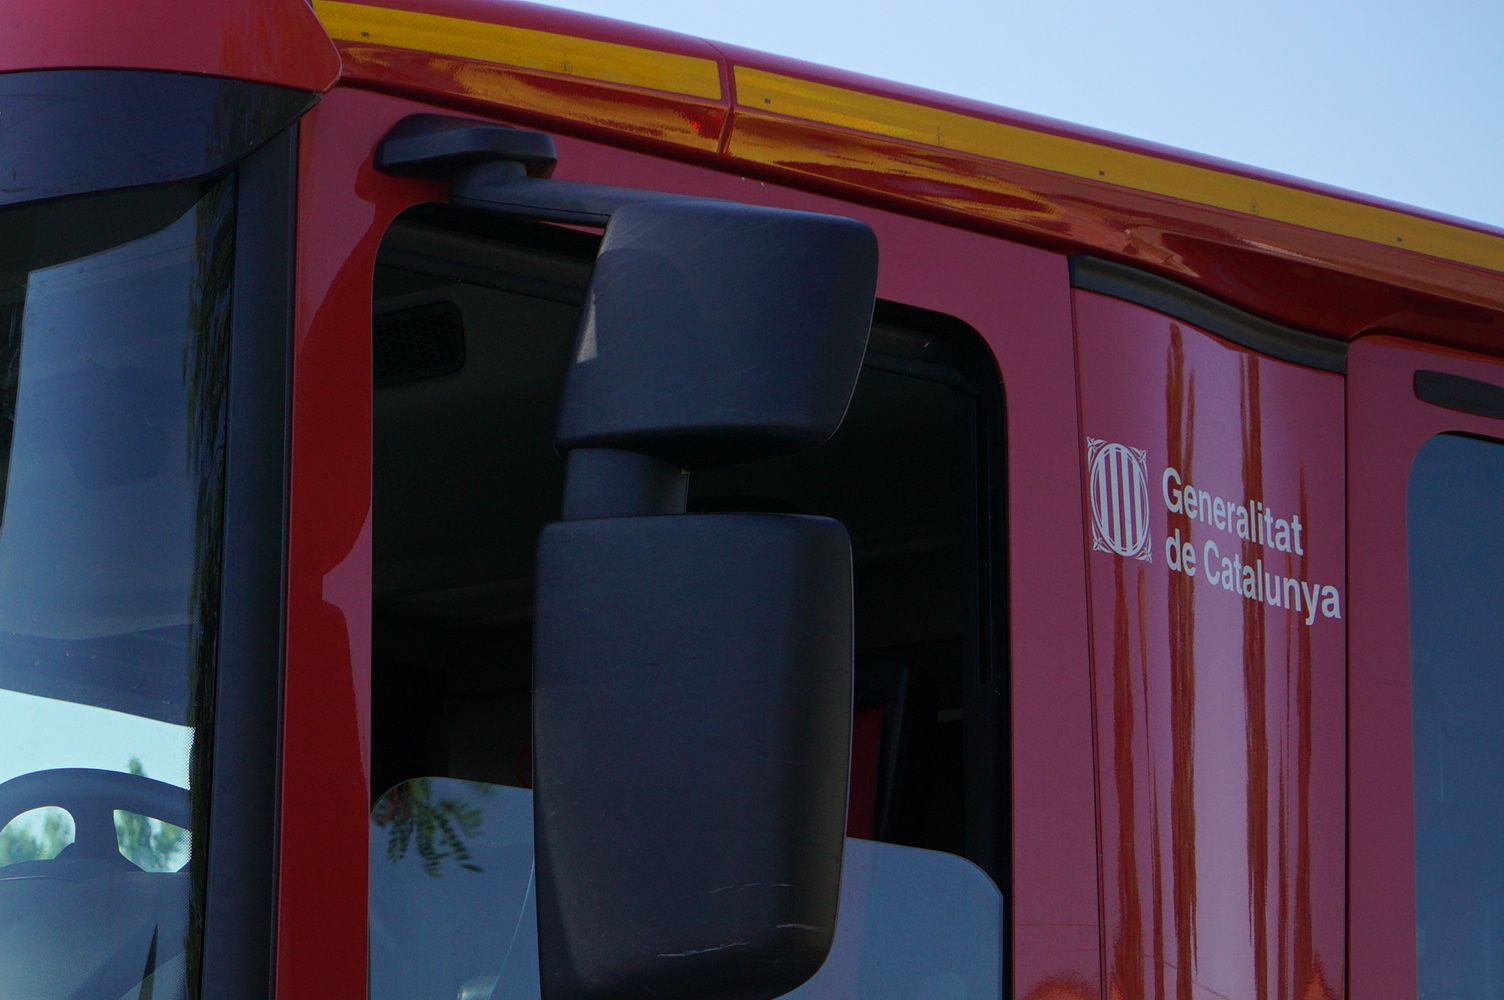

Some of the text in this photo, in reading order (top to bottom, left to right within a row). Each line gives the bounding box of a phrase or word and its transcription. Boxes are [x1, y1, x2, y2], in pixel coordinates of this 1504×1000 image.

[1162, 466, 1304, 556] Generalitat
[1165, 528, 1342, 627] de Catalunya
